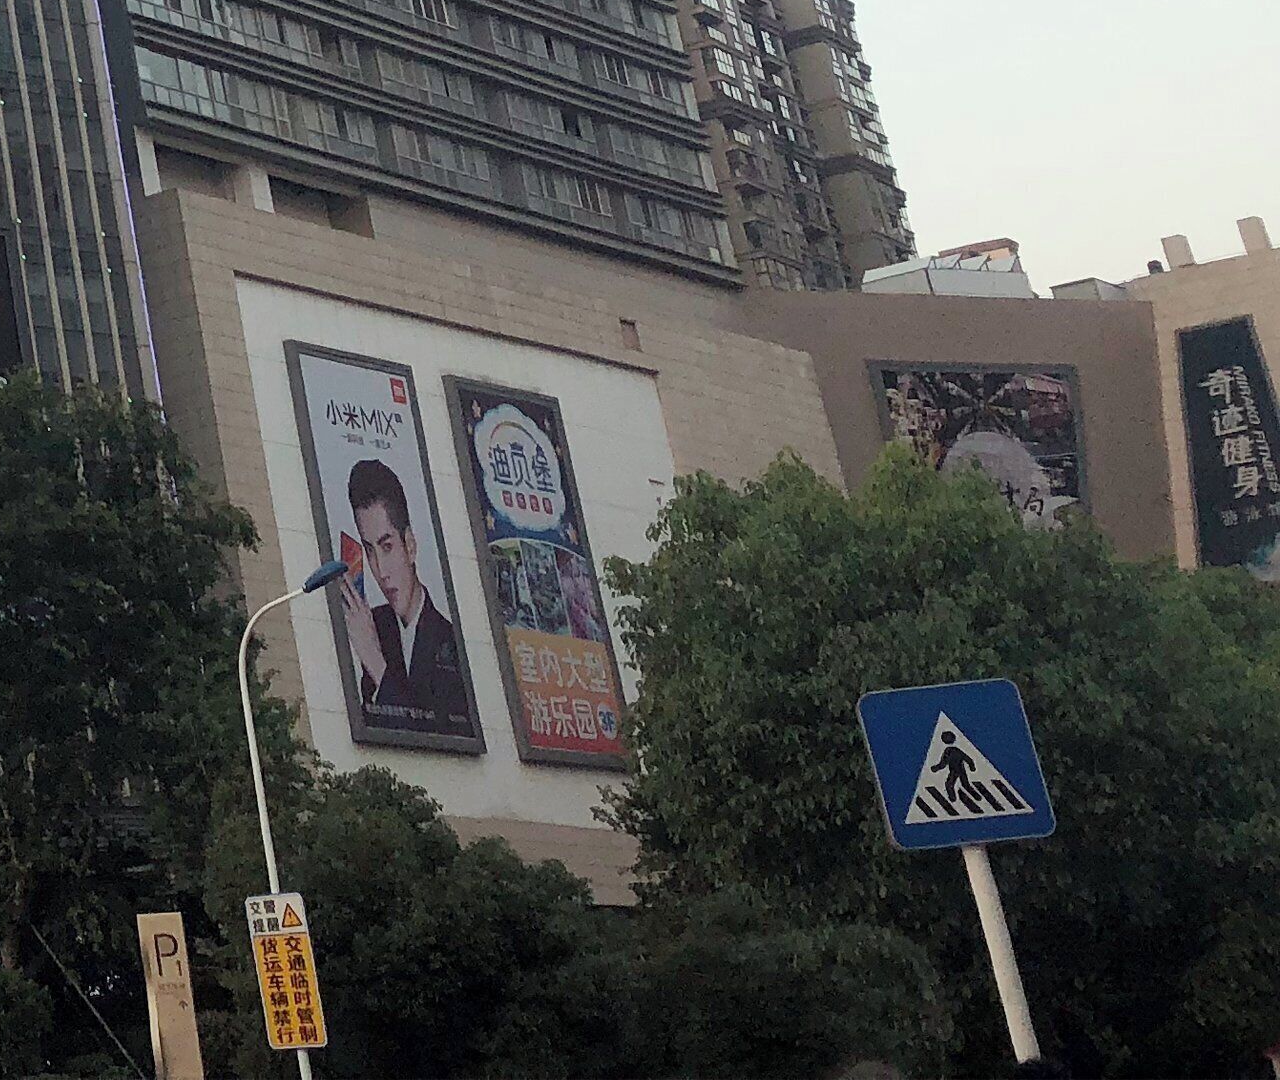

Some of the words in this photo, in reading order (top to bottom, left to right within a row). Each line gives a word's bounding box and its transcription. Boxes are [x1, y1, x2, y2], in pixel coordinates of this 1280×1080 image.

[515, 641, 610, 693] 室内大型
[523, 690, 598, 739] 游乐园
[260, 937, 295, 1044] 货运车辆禁行
[284, 935, 319, 1043] 交通临时管制
